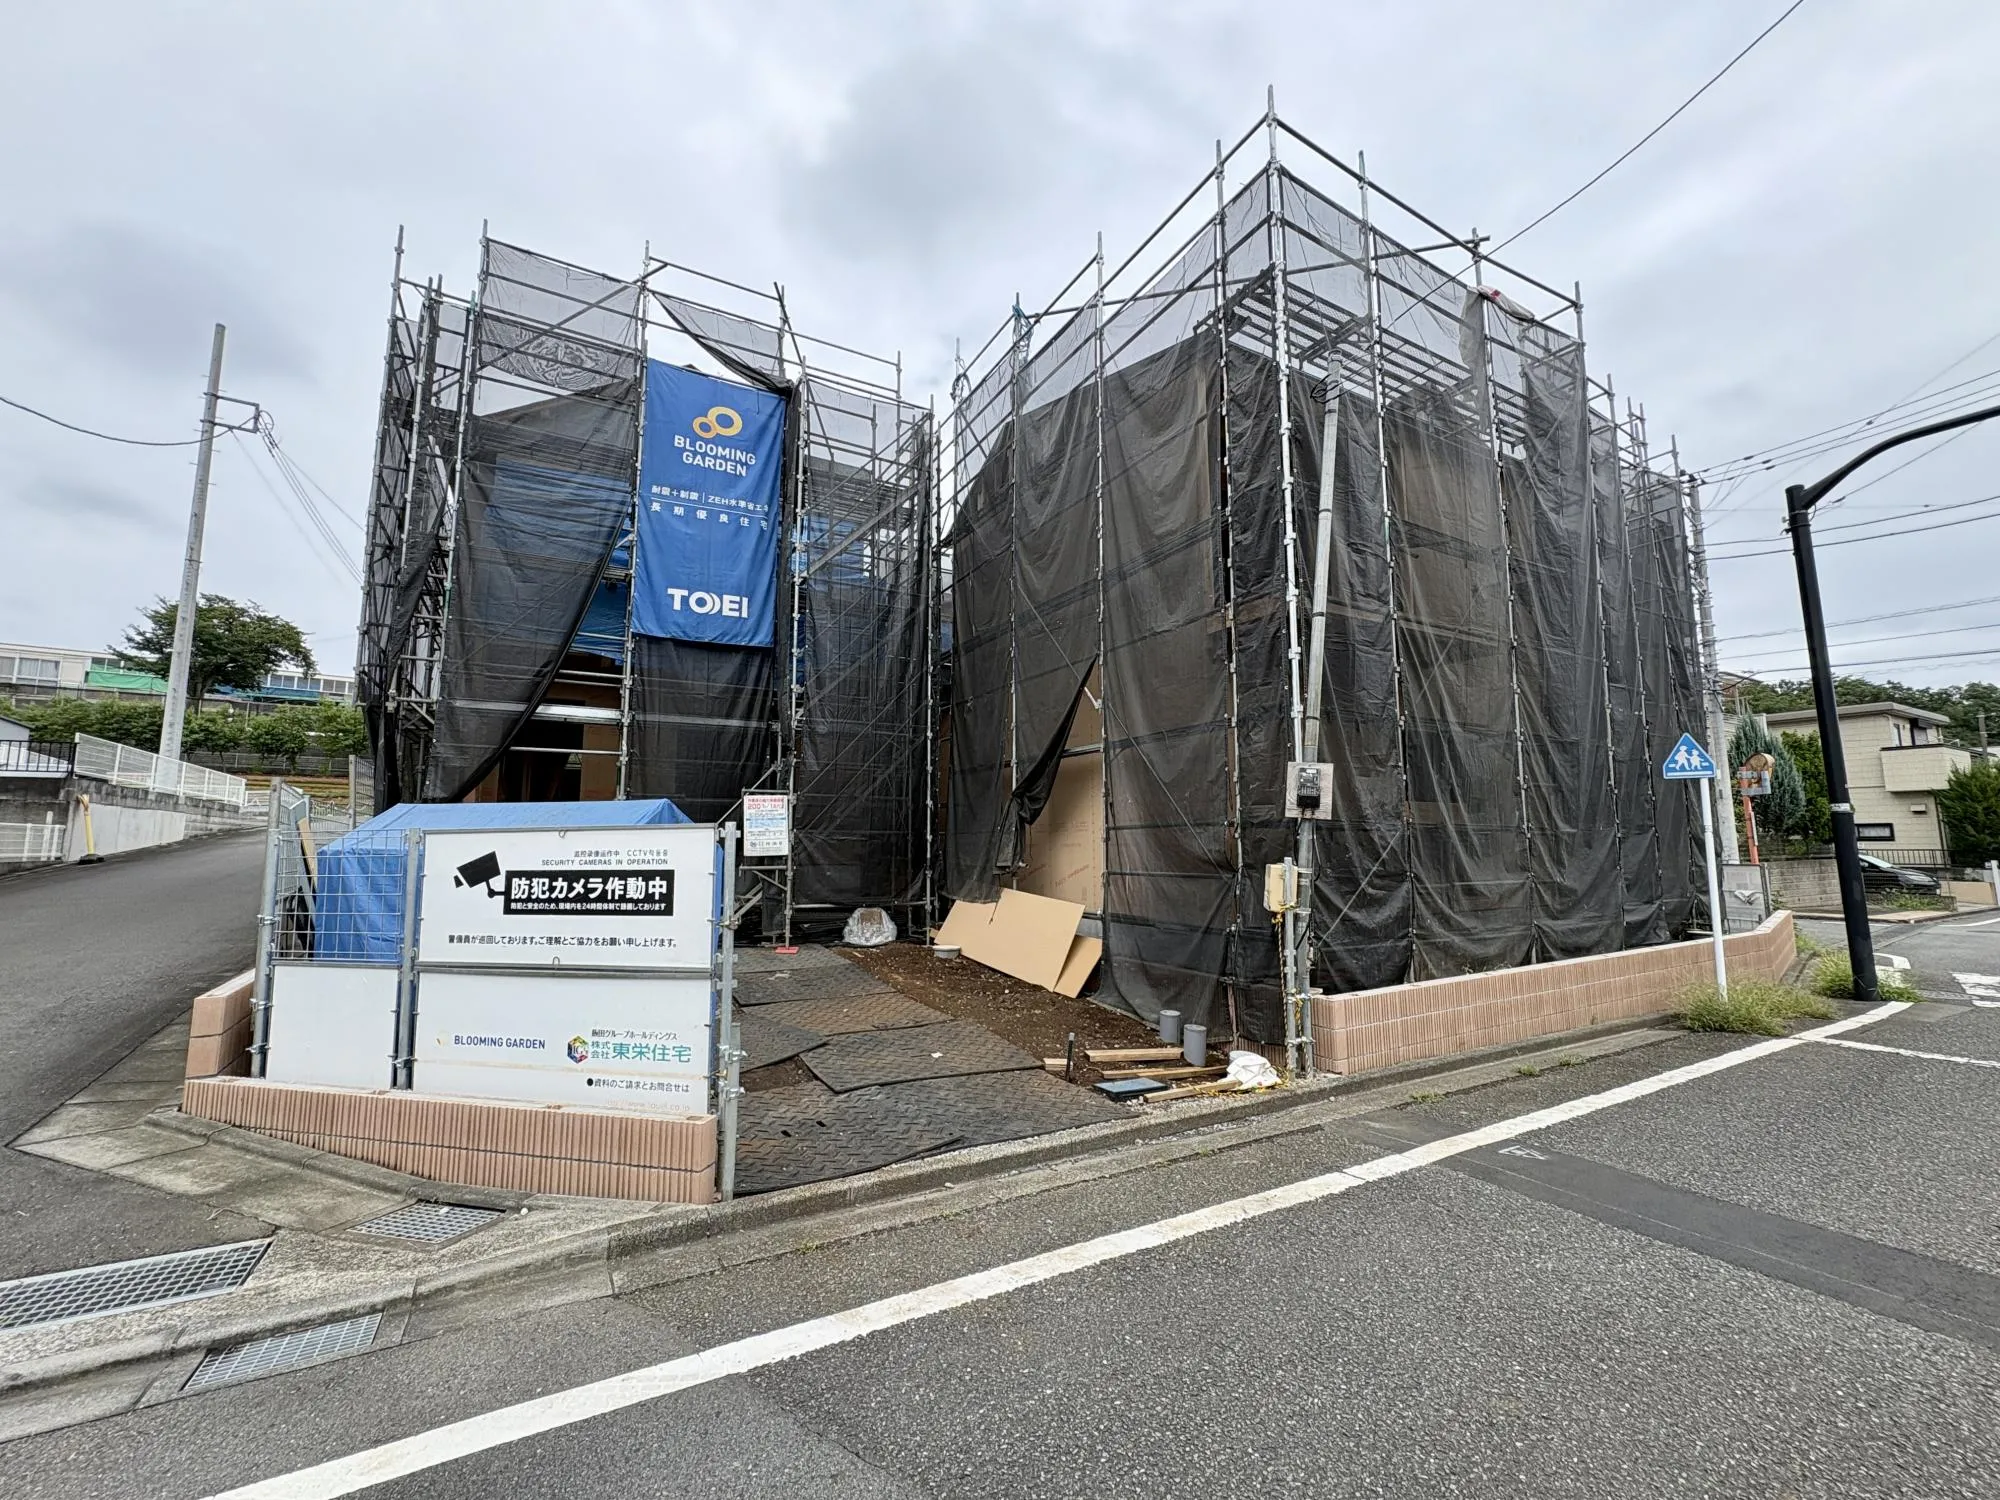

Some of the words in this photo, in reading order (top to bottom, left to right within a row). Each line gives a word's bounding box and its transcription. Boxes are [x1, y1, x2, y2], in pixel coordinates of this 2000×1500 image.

[674, 434, 756, 465] BLOOMING
[682, 452, 747, 477] GARDEN
[667, 588, 749, 618] TOEI
[626, 858, 669, 866] OPERATION
[511, 876, 668, 900] 防犯カメラ作動中
[454, 1035, 504, 1047] BLOOMING
[505, 1037, 546, 1049] GARDEN
[591, 1040, 611, 1050] 株式
[612, 1042, 692, 1063] 東栄住宅
[591, 1050, 610, 1060] 会社
